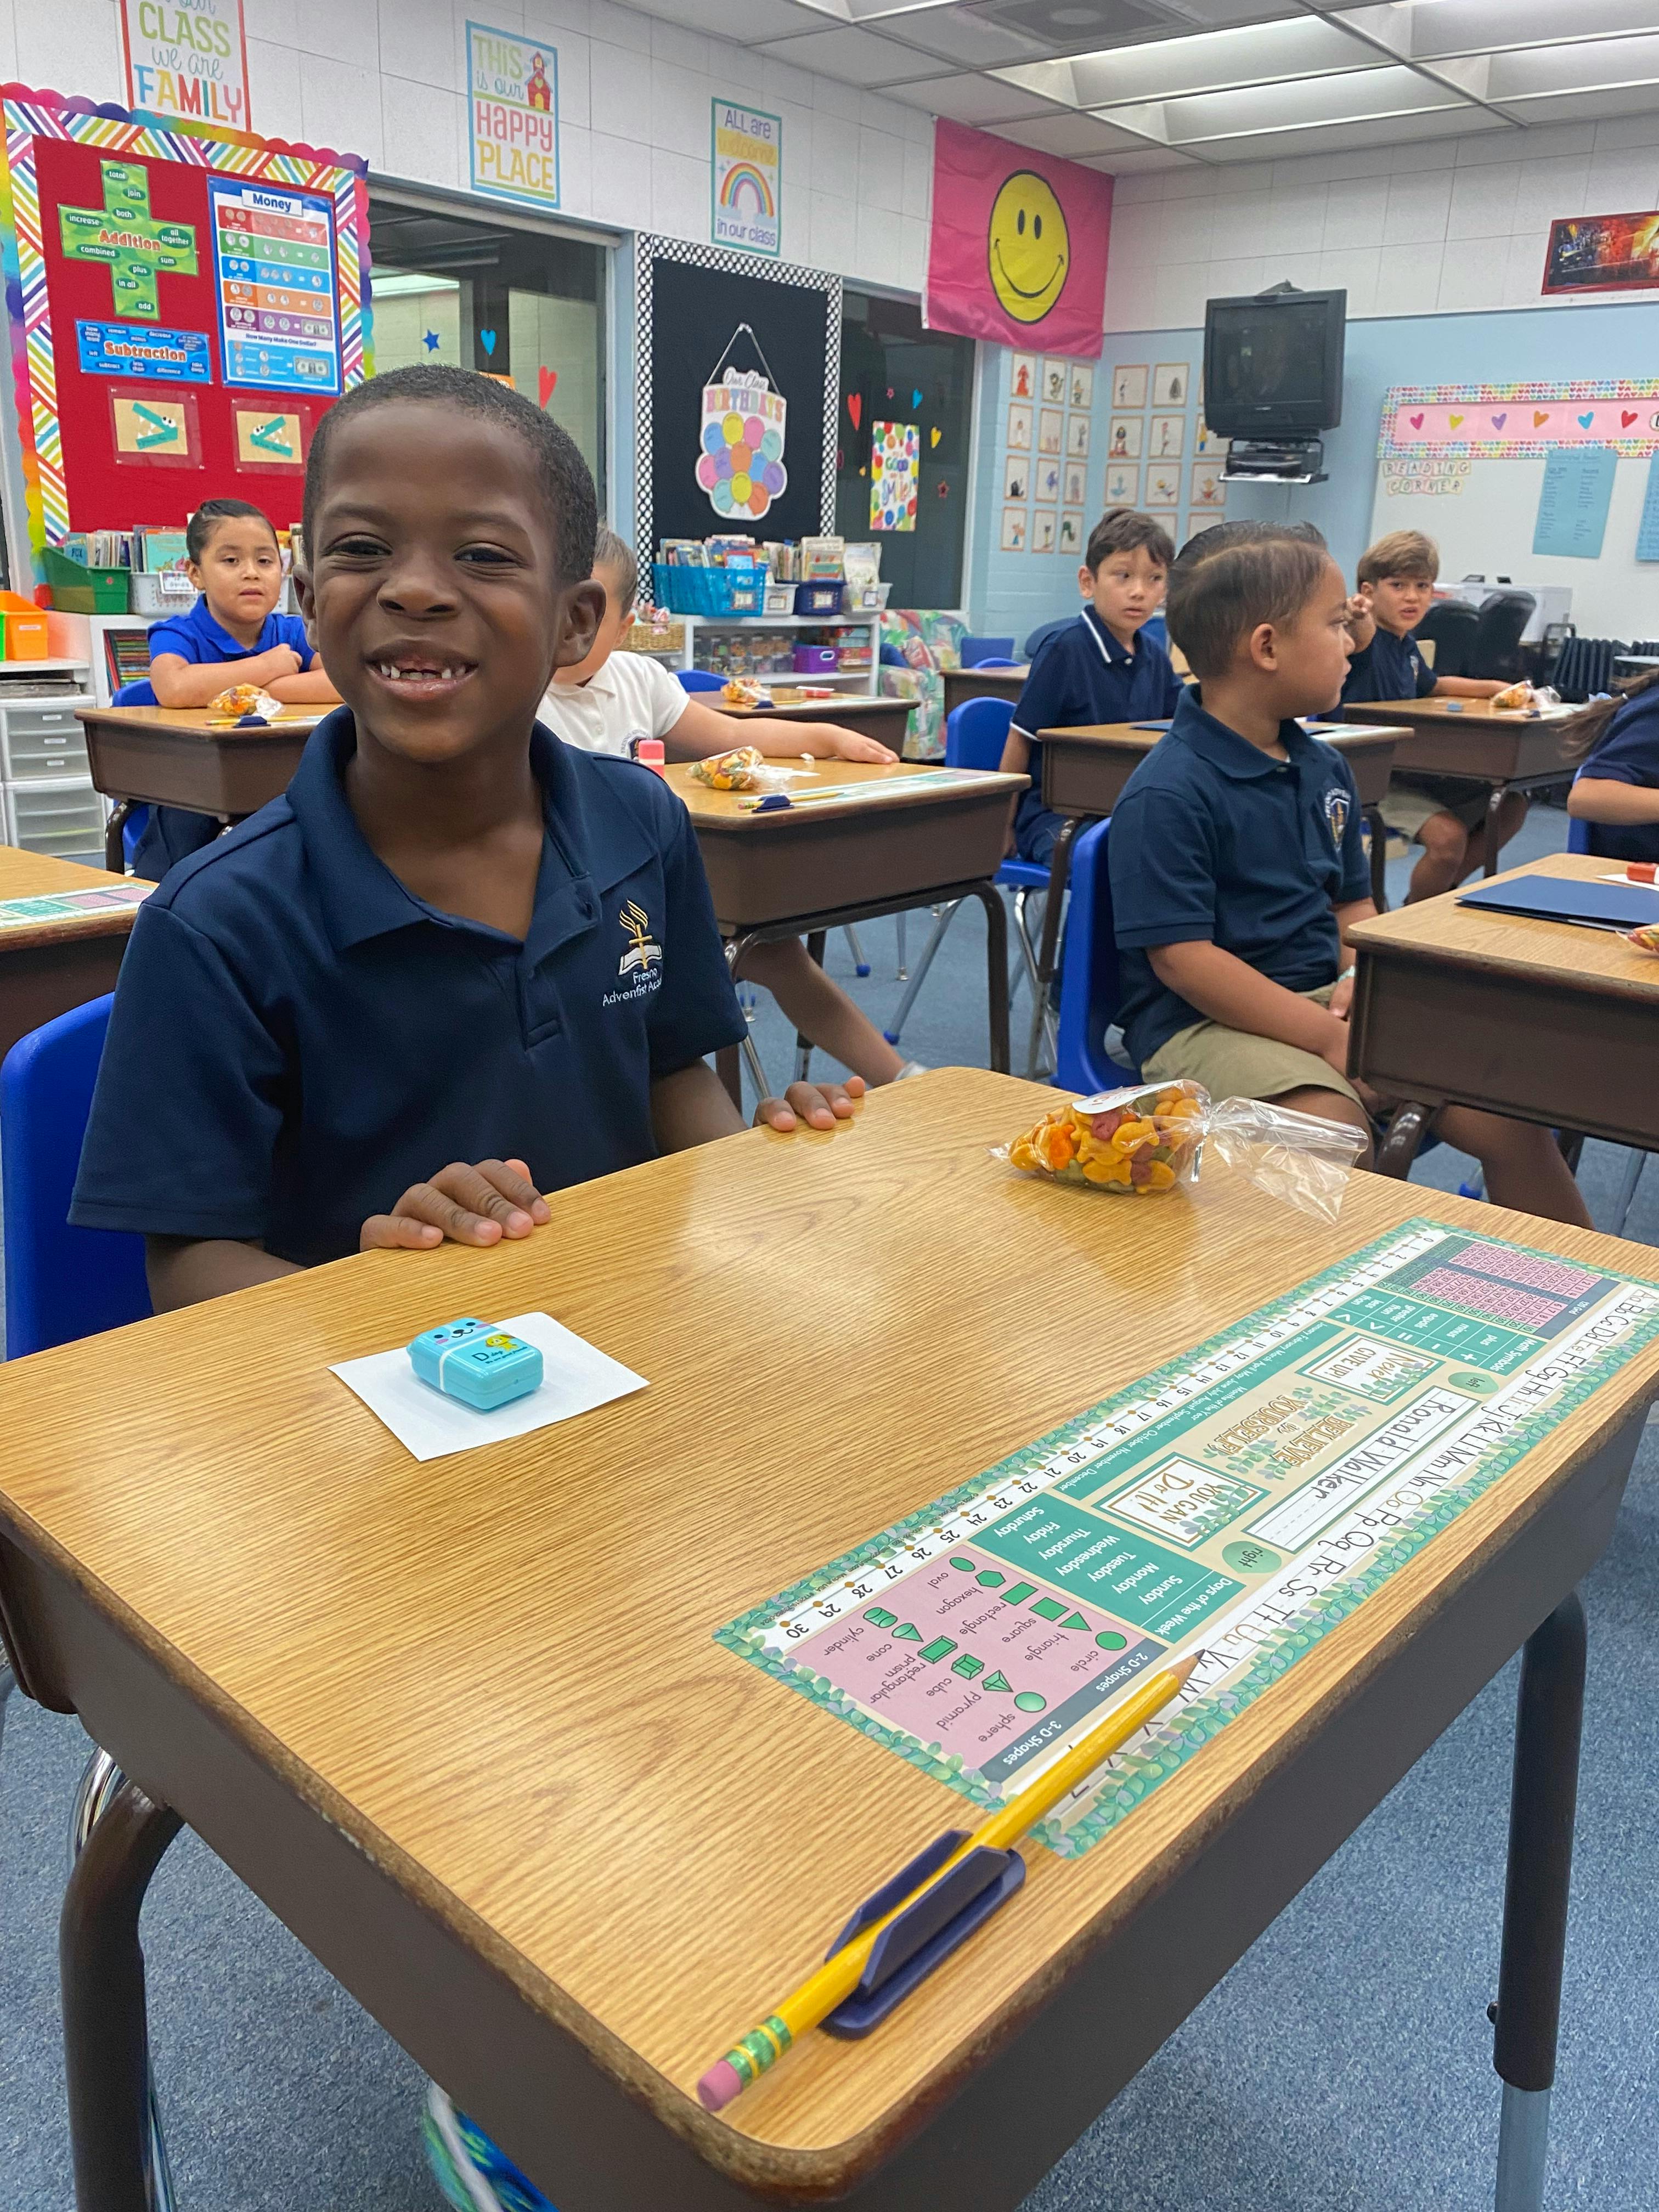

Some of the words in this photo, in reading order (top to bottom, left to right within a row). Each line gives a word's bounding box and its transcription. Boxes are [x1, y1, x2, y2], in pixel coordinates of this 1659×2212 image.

[139, 2, 230, 57] CLASS
[152, 47, 182, 70] we
[188, 53, 224, 80] are
[134, 64, 241, 123] FAMILY
[477, 70, 488, 91] is
[494, 78, 524, 100] our
[725, 110, 748, 133] ALL
[751, 118, 771, 139] are
[477, 139, 553, 190] PLACE
[127, 189, 141, 198] join
[252, 193, 292, 212] Money
[69, 215, 100, 225] increase
[116, 209, 132, 218] both
[98, 229, 161, 251] Addition
[717, 218, 727, 235] in
[729, 224, 746, 239] our
[748, 226, 776, 246] class
[80, 246, 115, 257] combined
[104, 341, 187, 363] Subtraction
[633, 967, 658, 985] Fresno
[602, 983, 647, 1007] Adventist
[1350, 1294, 1372, 1305] than
[1364, 1299, 1384, 1308] less
[1380, 1304, 1401, 1314] than
[1390, 1304, 1416, 1322] greater
[1568, 1306, 1583, 1315] Grid
[1414, 1312, 1438, 1328] equals
[1446, 1323, 1469, 1338] minus
[1479, 1333, 1498, 1346] plus
[1514, 1338, 1538, 1352] Math
[1262, 1349, 1285, 1362] March
[1340, 1347, 1376, 1367] GIVE
[1489, 1350, 1522, 1371] Symbols
[1233, 1369, 1253, 1379] May
[1248, 1360, 1266, 1372] April
[1324, 1364, 1353, 1379] UP!
[1366, 1352, 1418, 1383] Never
[1525, 1366, 1569, 1381] Gg
[1202, 1385, 1224, 1397] July
[1220, 1378, 1239, 1388] June
[1465, 1376, 1485, 1388] left
[1186, 1394, 1211, 1410] August
[1220, 1385, 1248, 1401] Months
[1150, 1407, 1190, 1430] September
[1190, 1410, 1211, 1420] Year
[1480, 1404, 1522, 1420] Jj
[1207, 1395, 1307, 1456] YOURSELF!
[1276, 1421, 1300, 1434] in
[1375, 1400, 1457, 1452] Ronald
[1472, 1417, 1510, 1434] Kk
[1127, 1429, 1158, 1447] October
[1271, 1414, 1353, 1467] BELIEVE
[1094, 1447, 1131, 1469] November
[1430, 1446, 1476, 1468] Mm
[1043, 1467, 1062, 1478] 21
[1059, 1468, 1097, 1491] December
[1307, 1450, 1394, 1504] Walker
[1408, 1469, 1448, 1487] Nn
[1017, 1482, 1038, 1493] 22
[1154, 1472, 1194, 1494] Do
[1130, 1491, 1167, 1513] It!
[1188, 1483, 1224, 1504] YOU
[1382, 1487, 1429, 1514] Oo
[993, 1497, 1013, 1509] 23
[1159, 1499, 1198, 1524] CAN
[966, 1513, 987, 1526] 24
[994, 1506, 1044, 1537] Saturday
[1354, 1508, 1402, 1526] Pp
[939, 1530, 960, 1543] 25
[1023, 1521, 1060, 1544] Friday
[1038, 1528, 1091, 1560] Thursday
[911, 1547, 932, 1560] 26
[1055, 1535, 1120, 1576] Wednesday
[1238, 1547, 1263, 1567] right
[884, 1565, 903, 1579] 27
[1087, 1551, 1136, 1582] Tuesday
[927, 1572, 949, 1589] oval
[1111, 1562, 1159, 1594] Monday
[1205, 1577, 1233, 1595] Days
[851, 1583, 873, 1599] 28
[1138, 1575, 1183, 1605] Sunday
[936, 1587, 983, 1614] hexagon
[1180, 1601, 1201, 1615] the
[1195, 1594, 1209, 1605] of
[818, 1603, 841, 1617] 29
[959, 1602, 1007, 1634] rectangle
[786, 1623, 809, 1638] 30
[1001, 1618, 1036, 1643] square
[1154, 1613, 1187, 1635] Week
[824, 1627, 864, 1655] cylinder
[1024, 1632, 1068, 1661] triangle
[866, 1643, 892, 1661] cone
[1070, 1650, 1098, 1672] circle
[1127, 1652, 1148, 1667] 2-D
[884, 1654, 916, 1677] prism
[870, 1658, 926, 1703] rectangular
[926, 1678, 952, 1696] cube
[1096, 1665, 1132, 1691] Shapes
[935, 1691, 981, 1730] pyramid
[978, 1713, 1015, 1742] sphere
[1039, 1720, 1062, 1737] 3-D
[1003, 1735, 1043, 1764] Shapes
